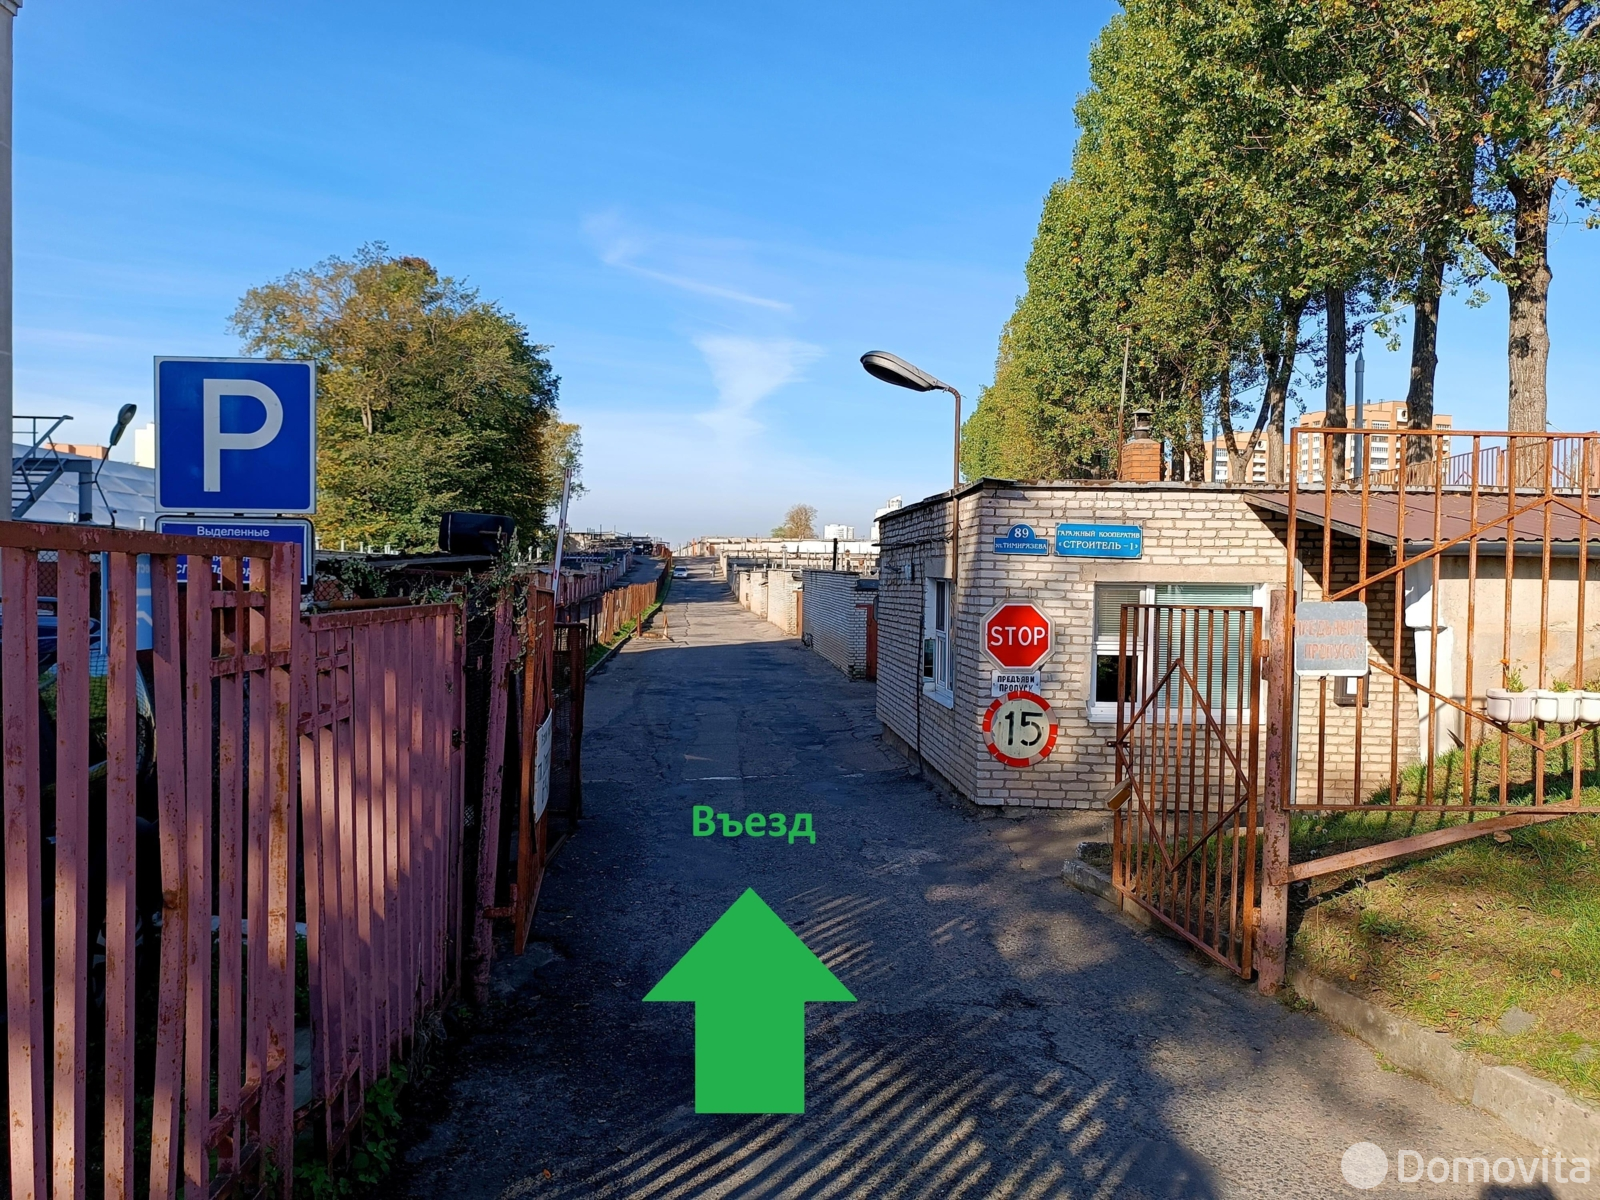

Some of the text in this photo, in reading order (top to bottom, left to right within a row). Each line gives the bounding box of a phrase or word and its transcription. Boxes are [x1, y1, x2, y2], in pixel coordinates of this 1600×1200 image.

[203, 378, 284, 492] P
[196, 526, 270, 537] Выделенные
[1014, 527, 1029, 539] 89
[1098, 531, 1140, 539] КООПЕРАТИВ
[990, 626, 1046, 646] STOP
[997, 675, 1035, 683] ПРЕДЪЯВИ
[998, 683, 1034, 692] ПРОПУСК
[1004, 711, 1043, 747] 15
